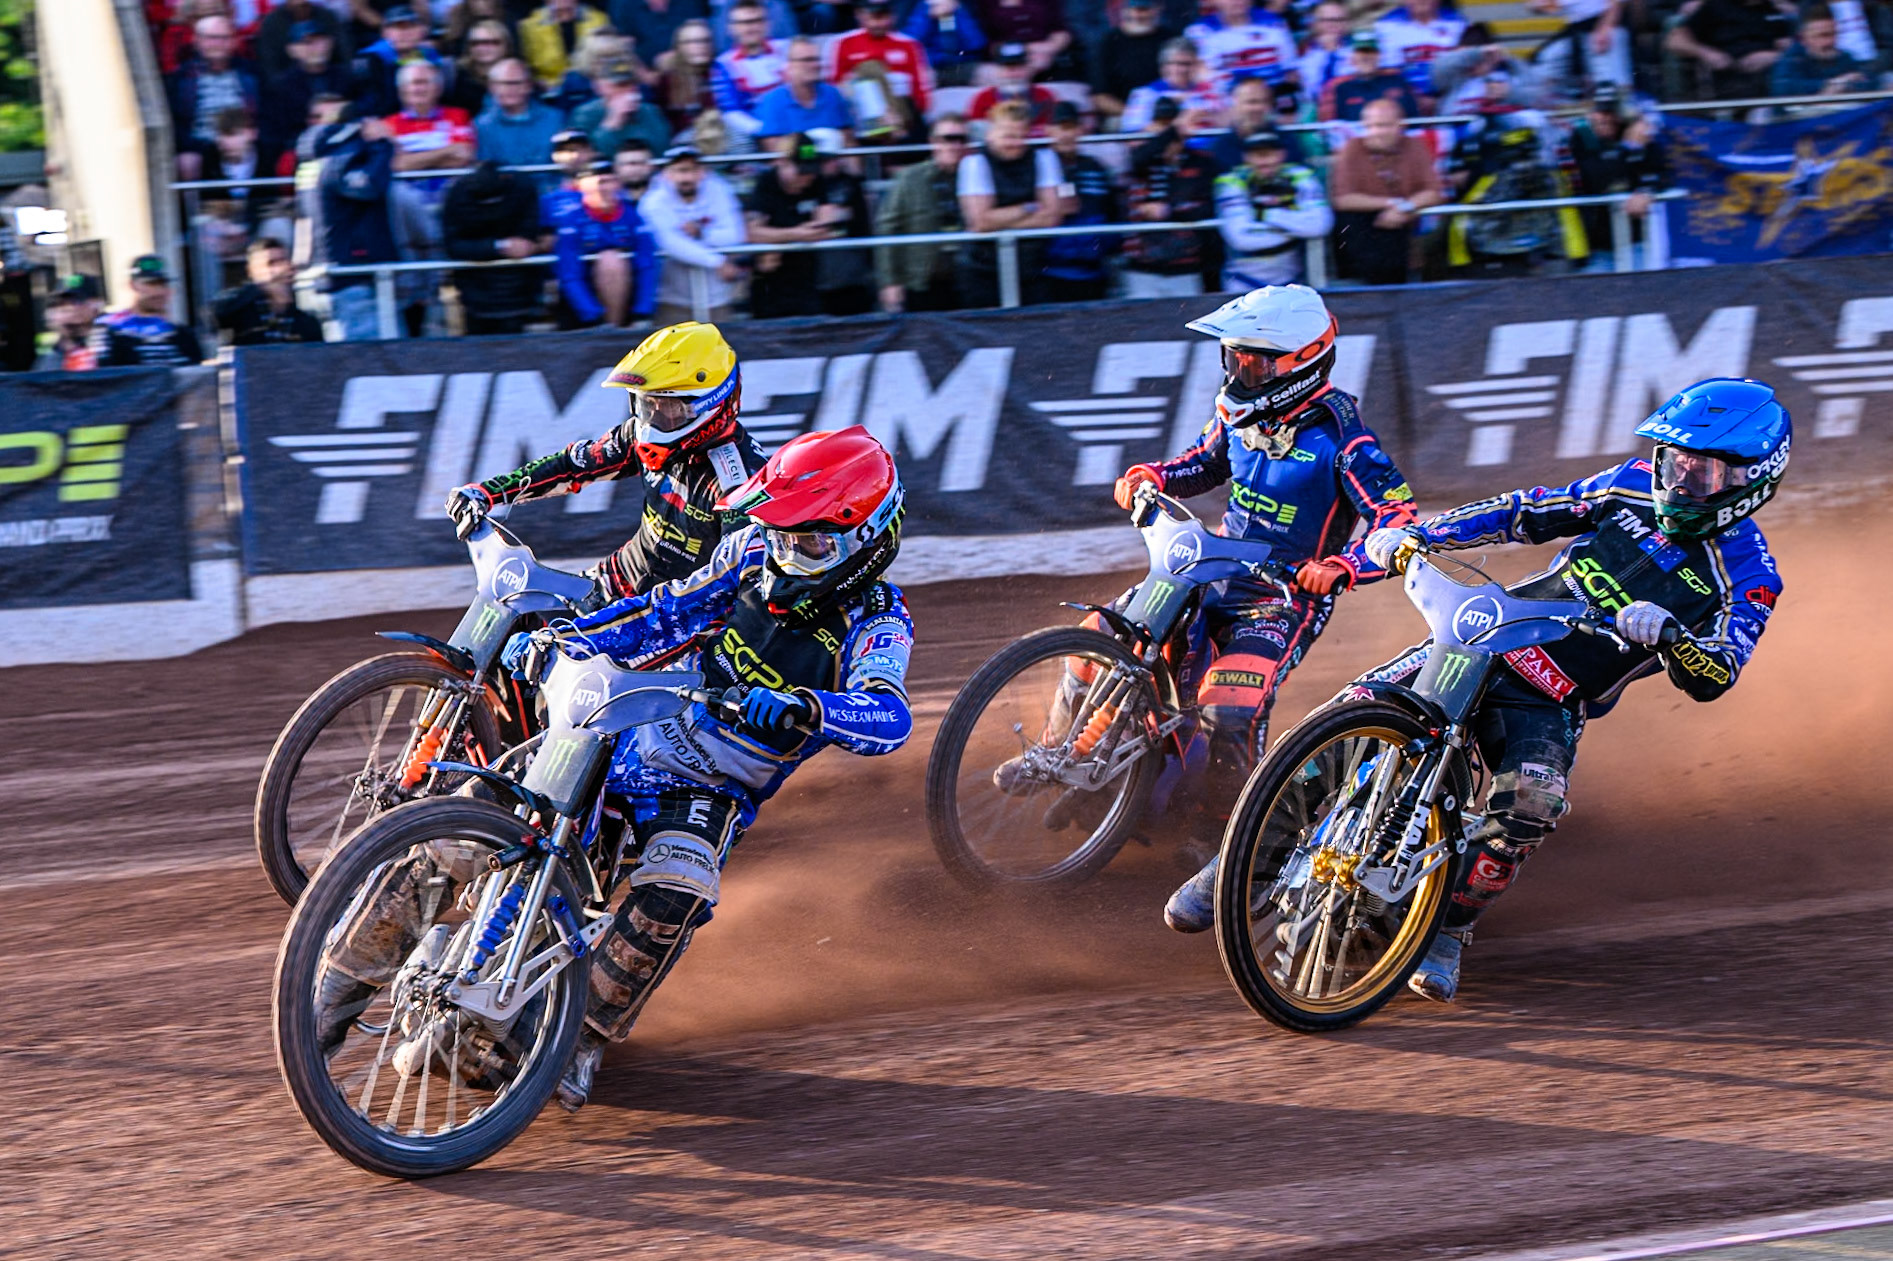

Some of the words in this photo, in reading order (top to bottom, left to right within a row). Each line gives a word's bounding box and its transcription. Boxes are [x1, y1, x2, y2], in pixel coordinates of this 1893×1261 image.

[1271, 371, 1321, 403] cellfast
[1425, 305, 1757, 467] FIM
[1637, 422, 1694, 444] BOLL
[1716, 482, 1772, 528] BOLL
[1611, 507, 1652, 540] FIM
[1169, 543, 1196, 563] ATPI
[497, 568, 522, 591] ATPI
[1677, 567, 1713, 596] SGP
[1459, 609, 1494, 630] ATPI
[1519, 646, 1569, 692] PAKT
[569, 688, 601, 709] ATPI
[659, 722, 688, 756] AUTO
